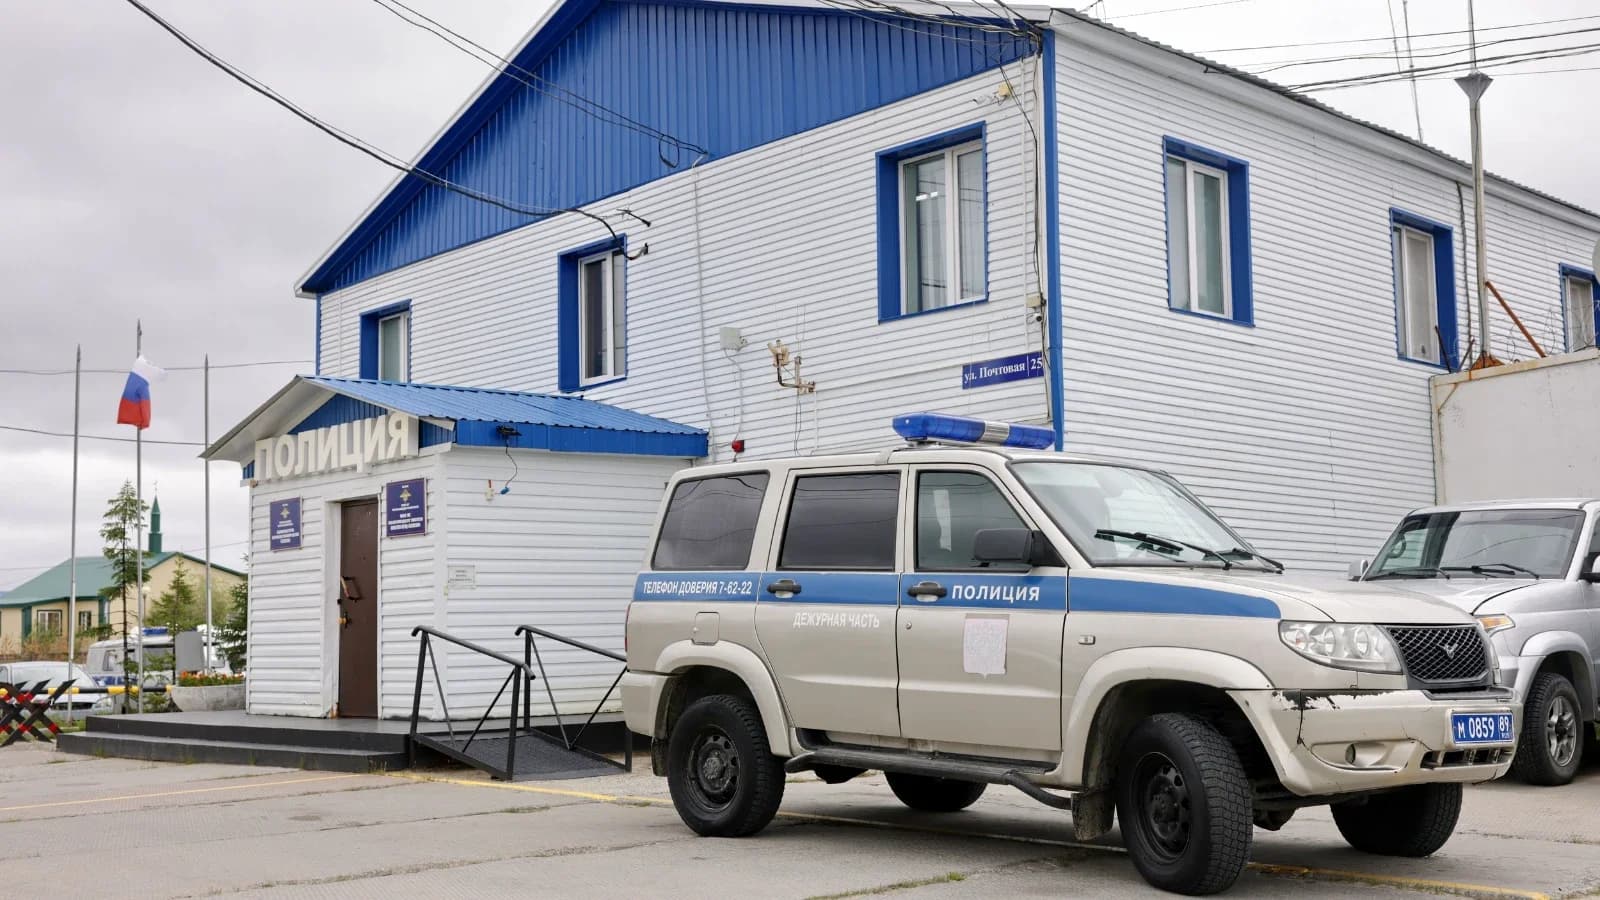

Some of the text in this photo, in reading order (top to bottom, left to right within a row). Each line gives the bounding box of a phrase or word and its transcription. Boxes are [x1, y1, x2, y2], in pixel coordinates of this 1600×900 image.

[964, 357, 1043, 384] ул. Почтовая 25
[254, 413, 411, 481] ПОЛИЦИЯ
[643, 581, 753, 596] ТЕЛЕФОН ДОВЕРИЯ 7-62-22
[952, 584, 1041, 604] ПОЛИЦИЯ
[792, 611, 880, 629] ДЕЖУРНАЯ ЧАСТЬ
[1468, 716, 1495, 739] 0859
[1499, 715, 1509, 732] 89
